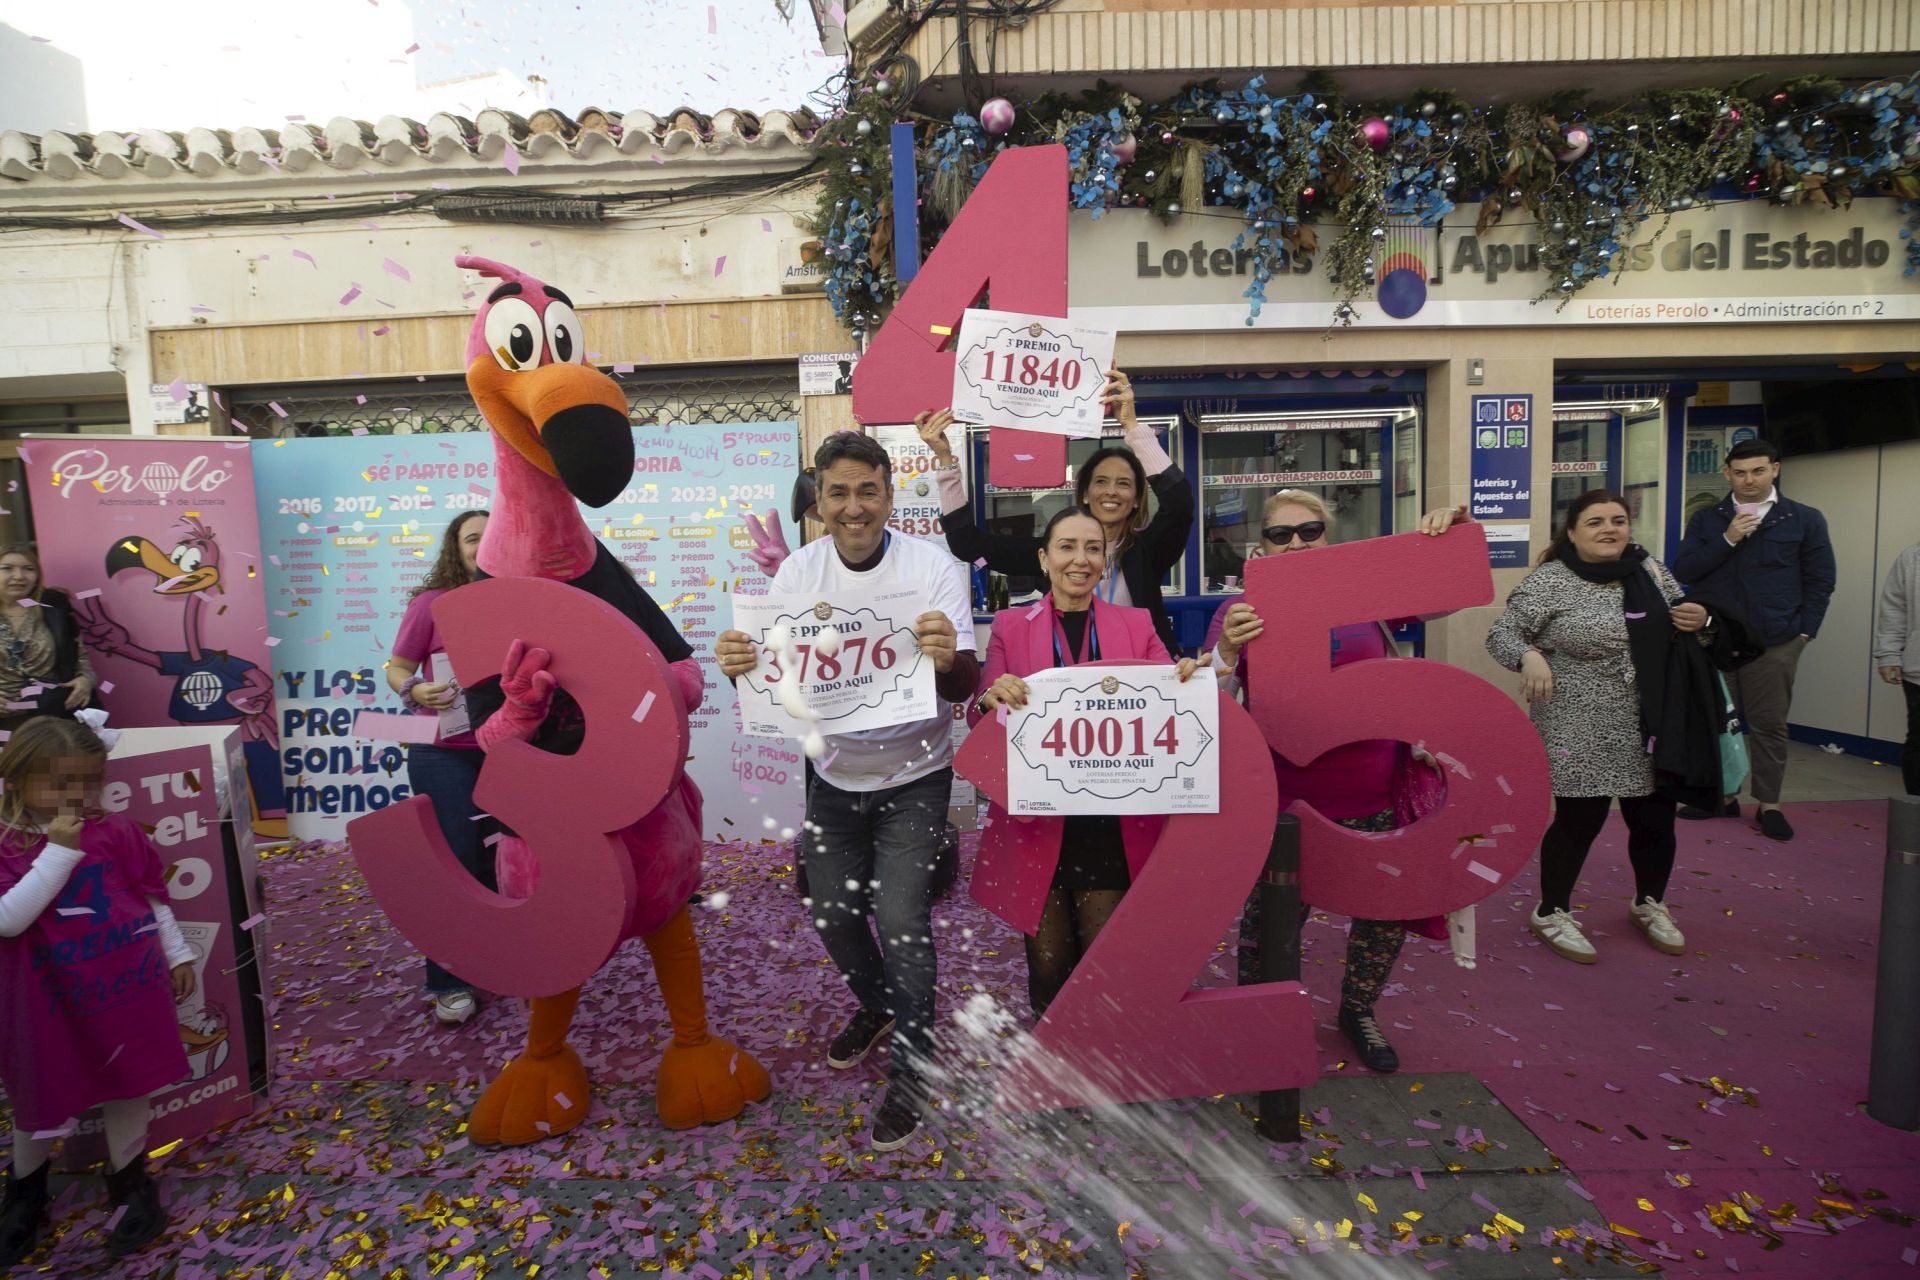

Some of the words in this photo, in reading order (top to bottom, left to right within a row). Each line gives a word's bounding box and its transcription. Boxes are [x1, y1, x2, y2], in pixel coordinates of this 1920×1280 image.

[1137, 240, 1312, 277] Loteras
[1450, 235, 1654, 283] Apuas
[1661, 229, 1729, 271] del
[1743, 227, 1889, 270] Estado
[1587, 303, 1651, 319] Loterías
[1656, 304, 1708, 318] Perolo
[1723, 303, 1847, 318] Administración
[1875, 301, 1884, 315] 2
[1015, 339, 1061, 352] PREMIO
[802, 353, 858, 363] CONECTADA
[981, 351, 1081, 390] 11840
[997, 384, 1035, 396] VENDIDO
[1036, 388, 1059, 398] AQUÍ
[1474, 478, 1510, 488] Loterías
[1511, 480, 1517, 489] y
[279, 498, 322, 514] 2016
[334, 496, 377, 512] 2017
[444, 493, 488, 509] 2019
[614, 486, 659, 504] 2022
[671, 485, 717, 503] 2023
[728, 484, 776, 500] 2024
[1474, 491, 1513, 502] Apuestas
[1515, 491, 1529, 501] del
[903, 508, 942, 517] PREM
[1474, 505, 1503, 514] Estado
[683, 527, 712, 535] GORDO
[887, 517, 945, 535] 5830
[625, 529, 654, 537] GORDO
[680, 566, 705, 574] 58303
[801, 621, 862, 638] PRMIO
[284, 672, 306, 698] Y
[314, 669, 376, 698] LOS
[844, 675, 873, 688] AQUÍ
[1086, 698, 1147, 711] PREMIO
[1041, 715, 1179, 757] 40014
[1069, 759, 1121, 769] VENDIDO
[1125, 756, 1154, 768] AQUÍ
